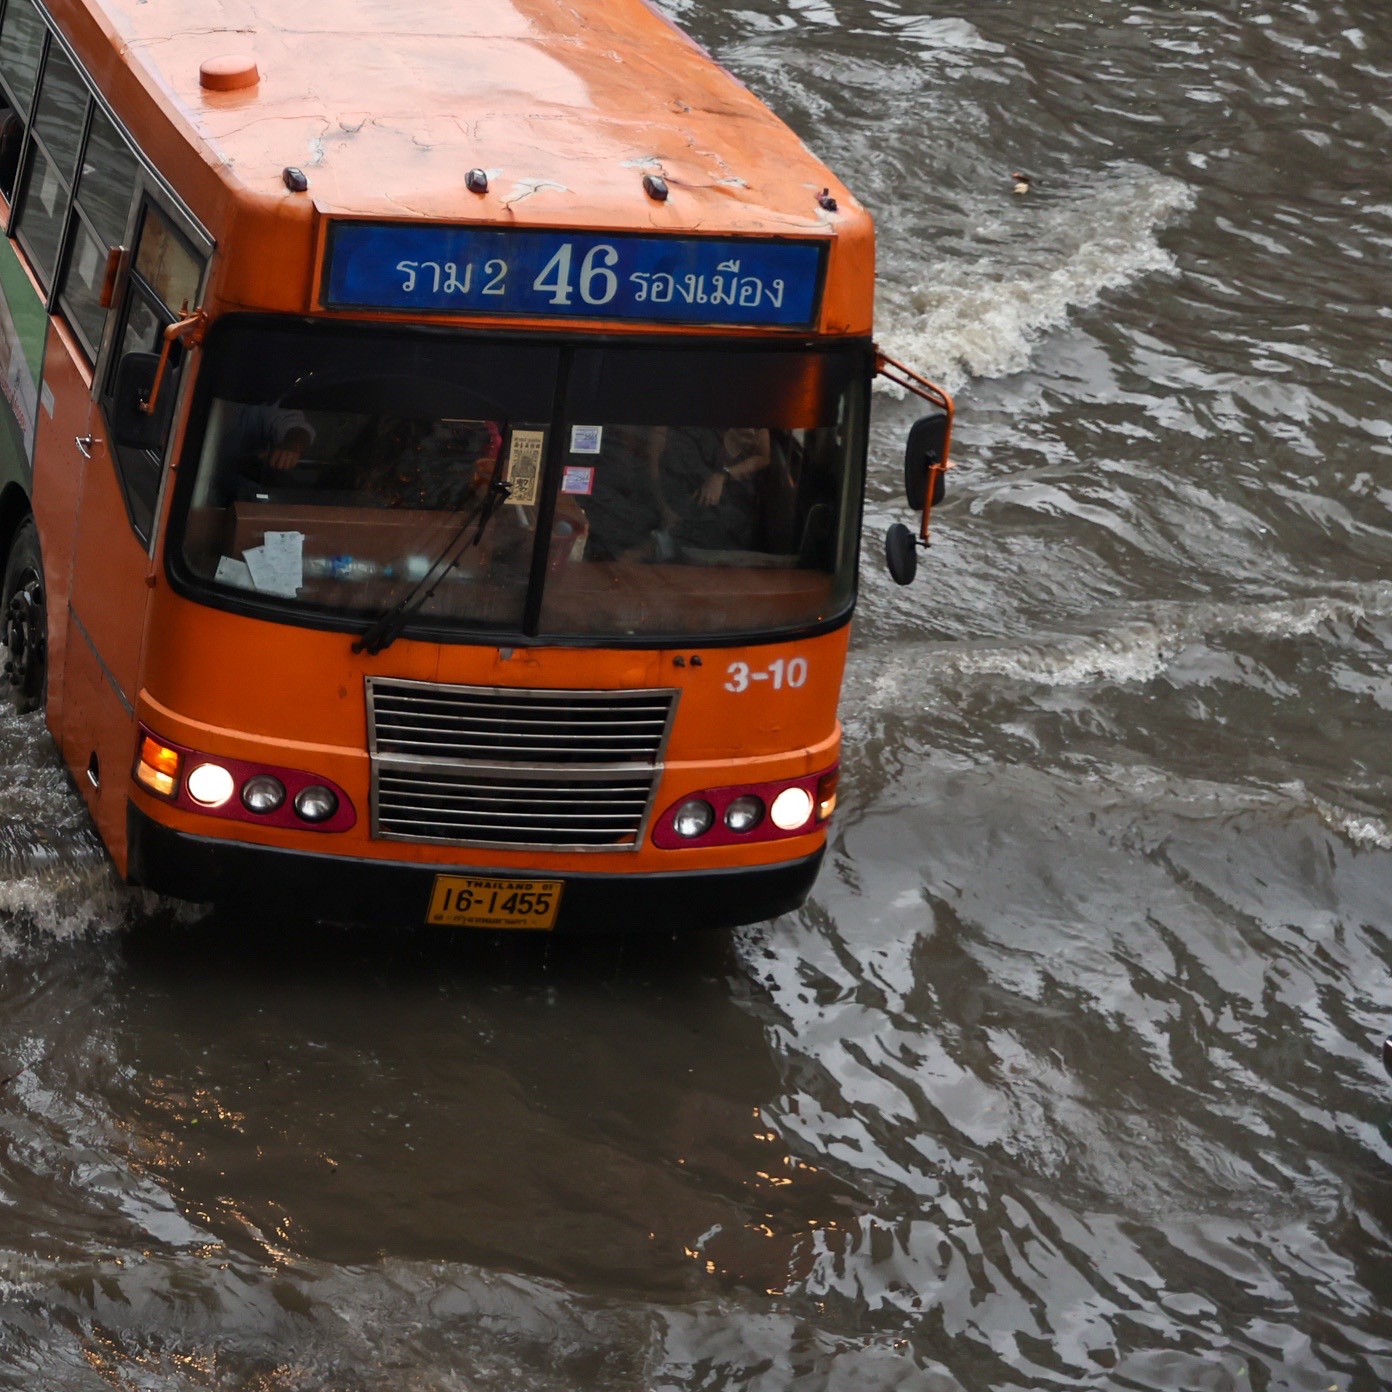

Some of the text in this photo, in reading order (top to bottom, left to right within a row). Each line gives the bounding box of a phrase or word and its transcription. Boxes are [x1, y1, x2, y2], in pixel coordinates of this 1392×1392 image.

[396, 243, 785, 308] ราม 2 46 รองเมือง
[724, 657, 808, 693] 3-10
[465, 880, 534, 891] THAILAND
[442, 888, 553, 915] 16-1455
